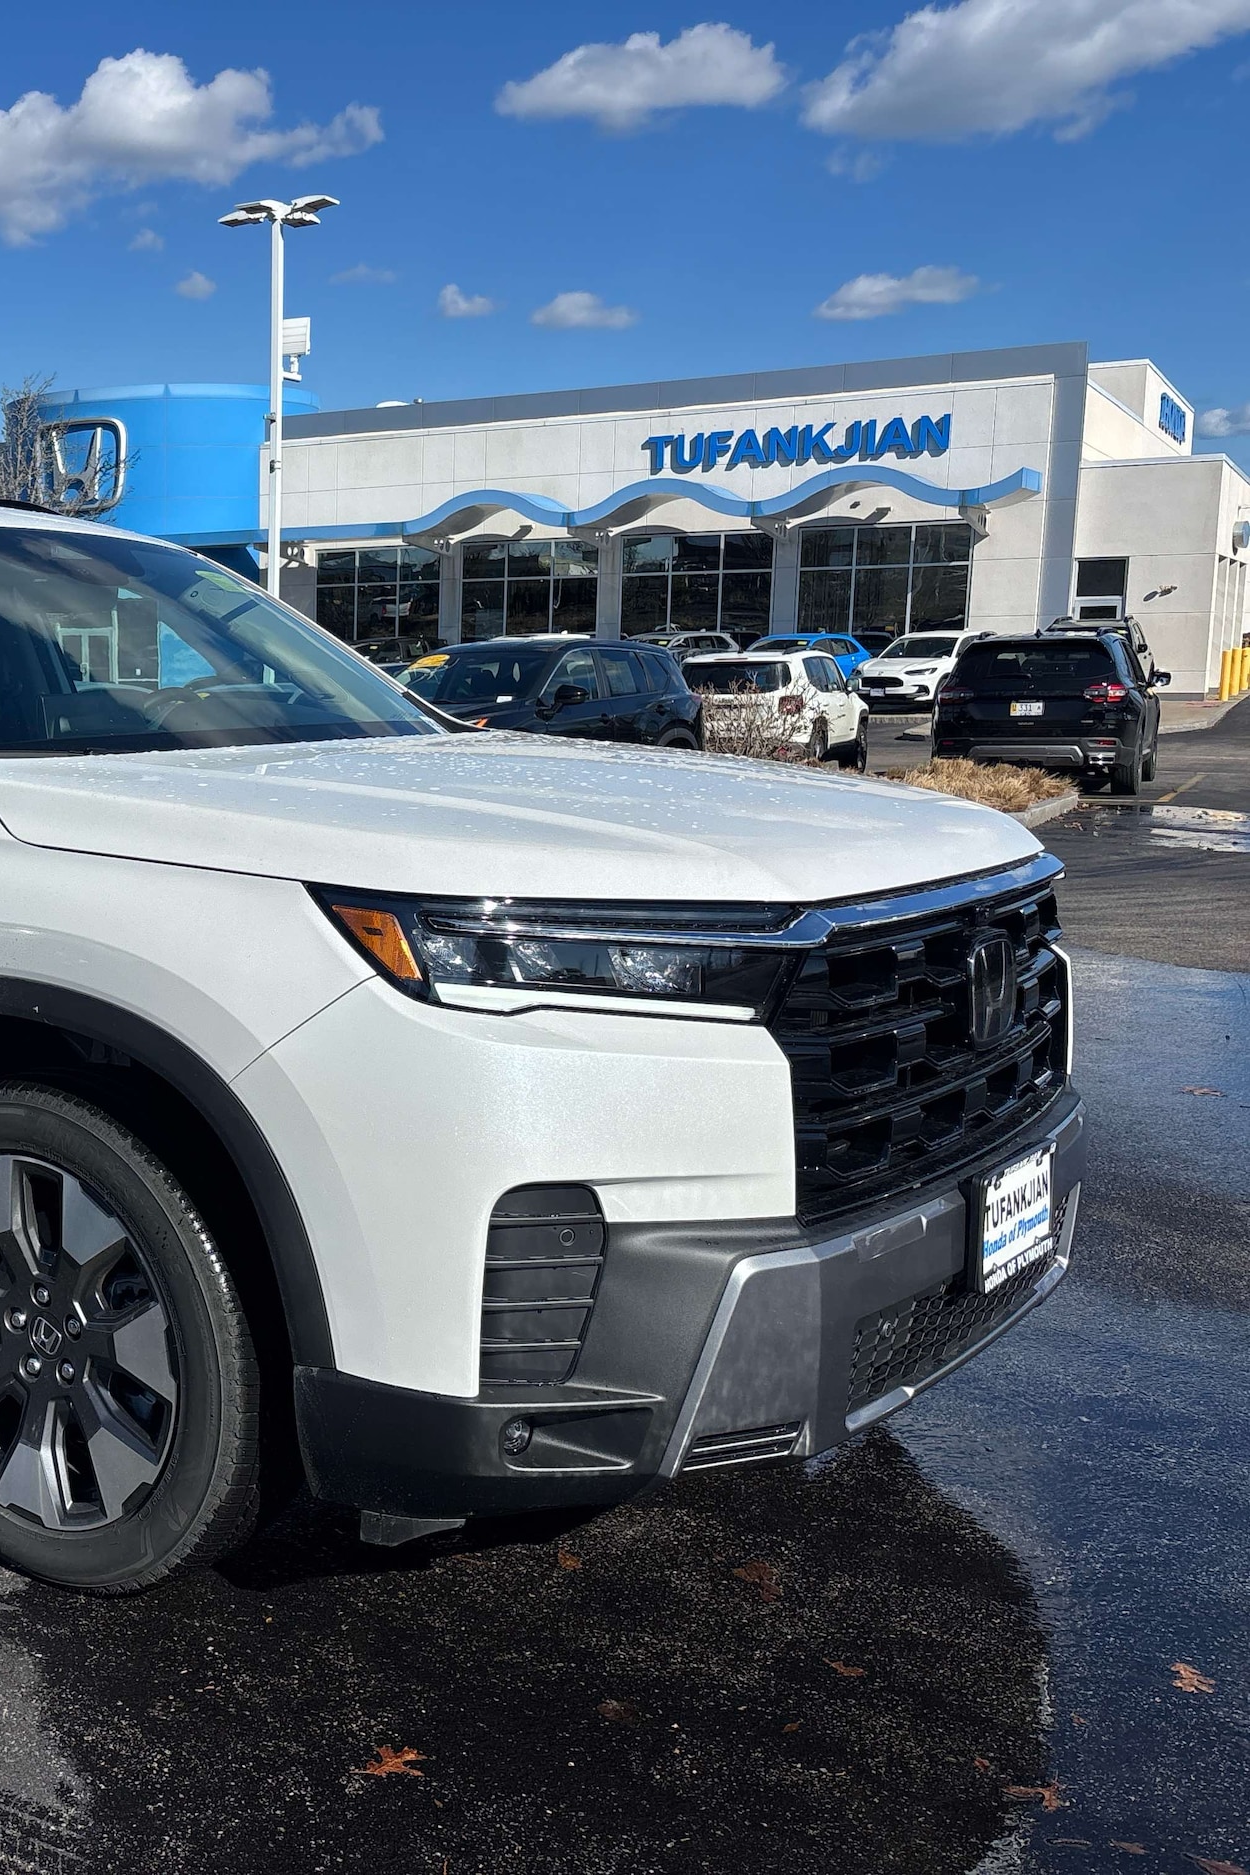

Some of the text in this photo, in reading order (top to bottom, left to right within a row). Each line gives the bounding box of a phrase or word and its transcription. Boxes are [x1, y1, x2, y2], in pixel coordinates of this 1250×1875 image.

[644, 413, 952, 473] TUFANKJIAN
[1018, 703, 1033, 712] 331
[983, 1170, 1049, 1232] TUFANKJIAN
[983, 1204, 1049, 1259] Honda of Plymouth
[984, 1237, 1053, 1294] HONDA OF PLYMOUTH
